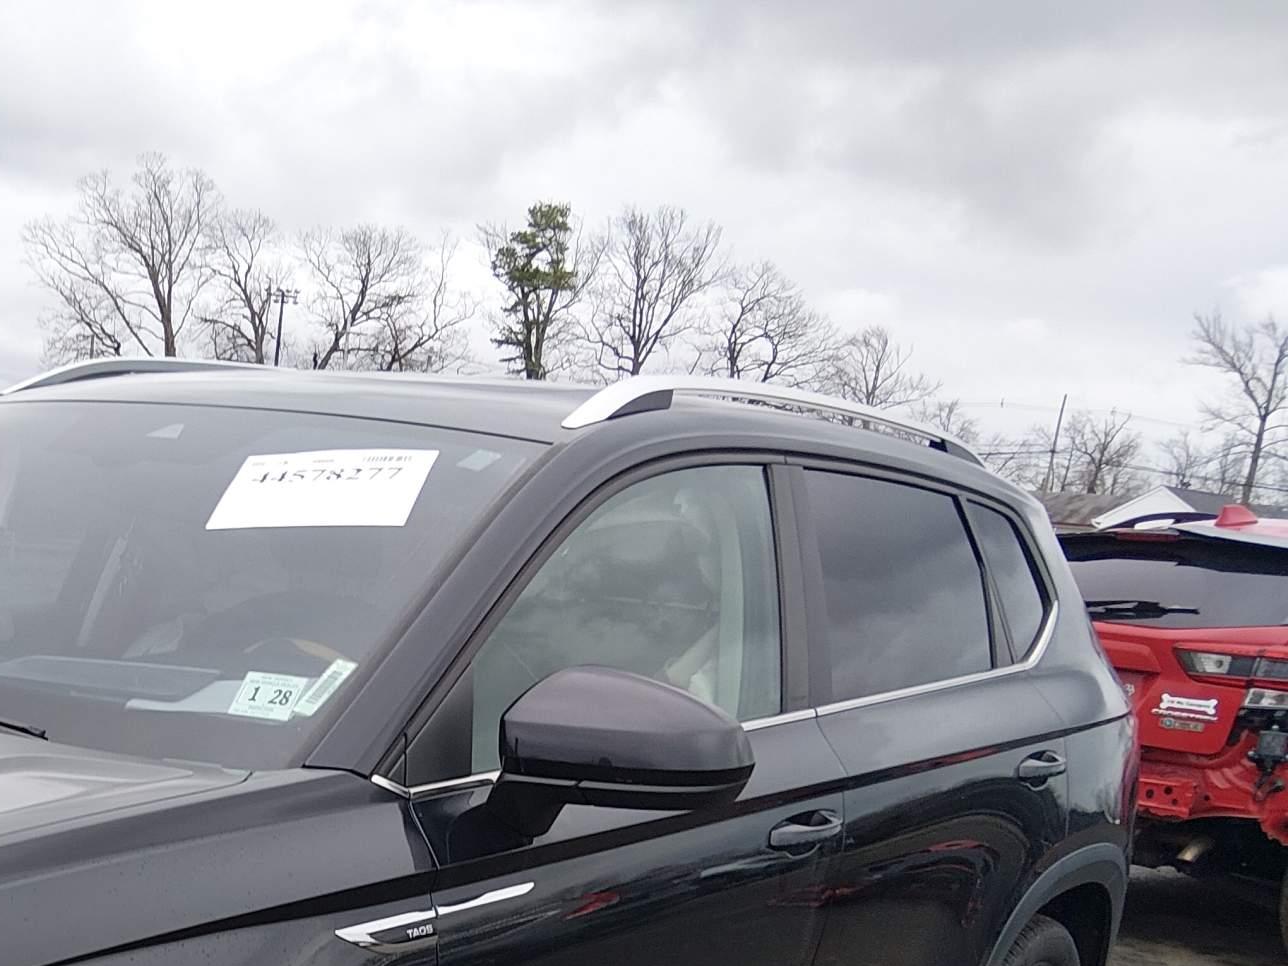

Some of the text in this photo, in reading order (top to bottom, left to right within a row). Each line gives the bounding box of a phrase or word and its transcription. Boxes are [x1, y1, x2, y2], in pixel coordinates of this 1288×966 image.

[251, 466, 404, 484] 44578277
[248, 686, 293, 706] 1 28
[406, 923, 434, 940] TAOS
